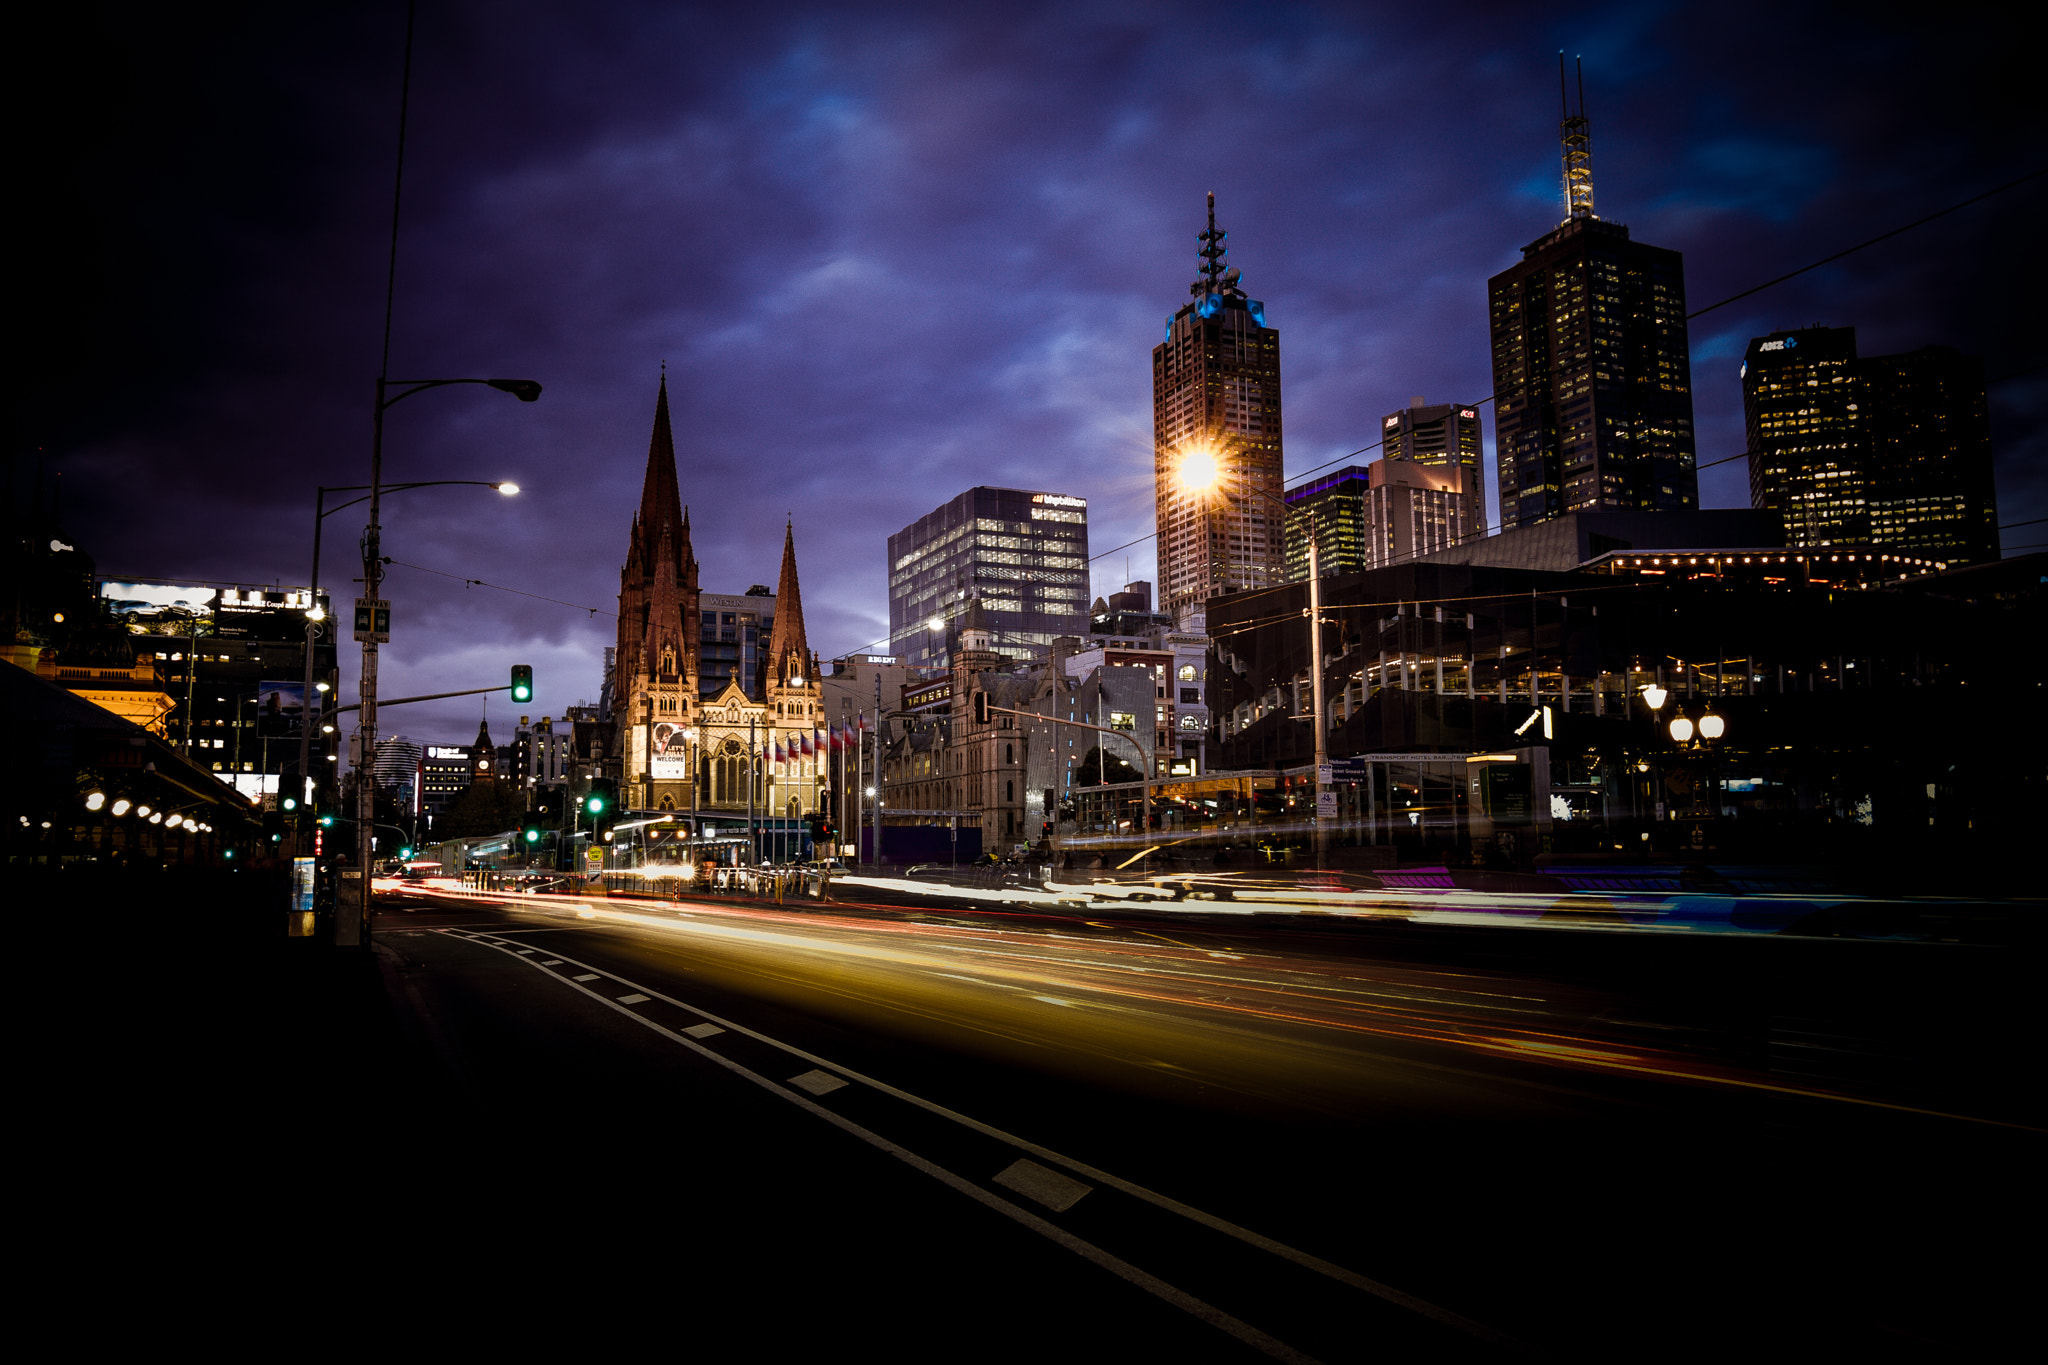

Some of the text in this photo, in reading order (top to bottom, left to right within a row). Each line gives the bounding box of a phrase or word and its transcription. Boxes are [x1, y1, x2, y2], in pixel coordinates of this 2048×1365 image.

[1759, 340, 1784, 352] ANZ
[267, 601, 284, 609] Coupé
[357, 599, 388, 607] FAIRWAY
[709, 596, 744, 607] WESTIN
[867, 656, 896, 664] REGENT
